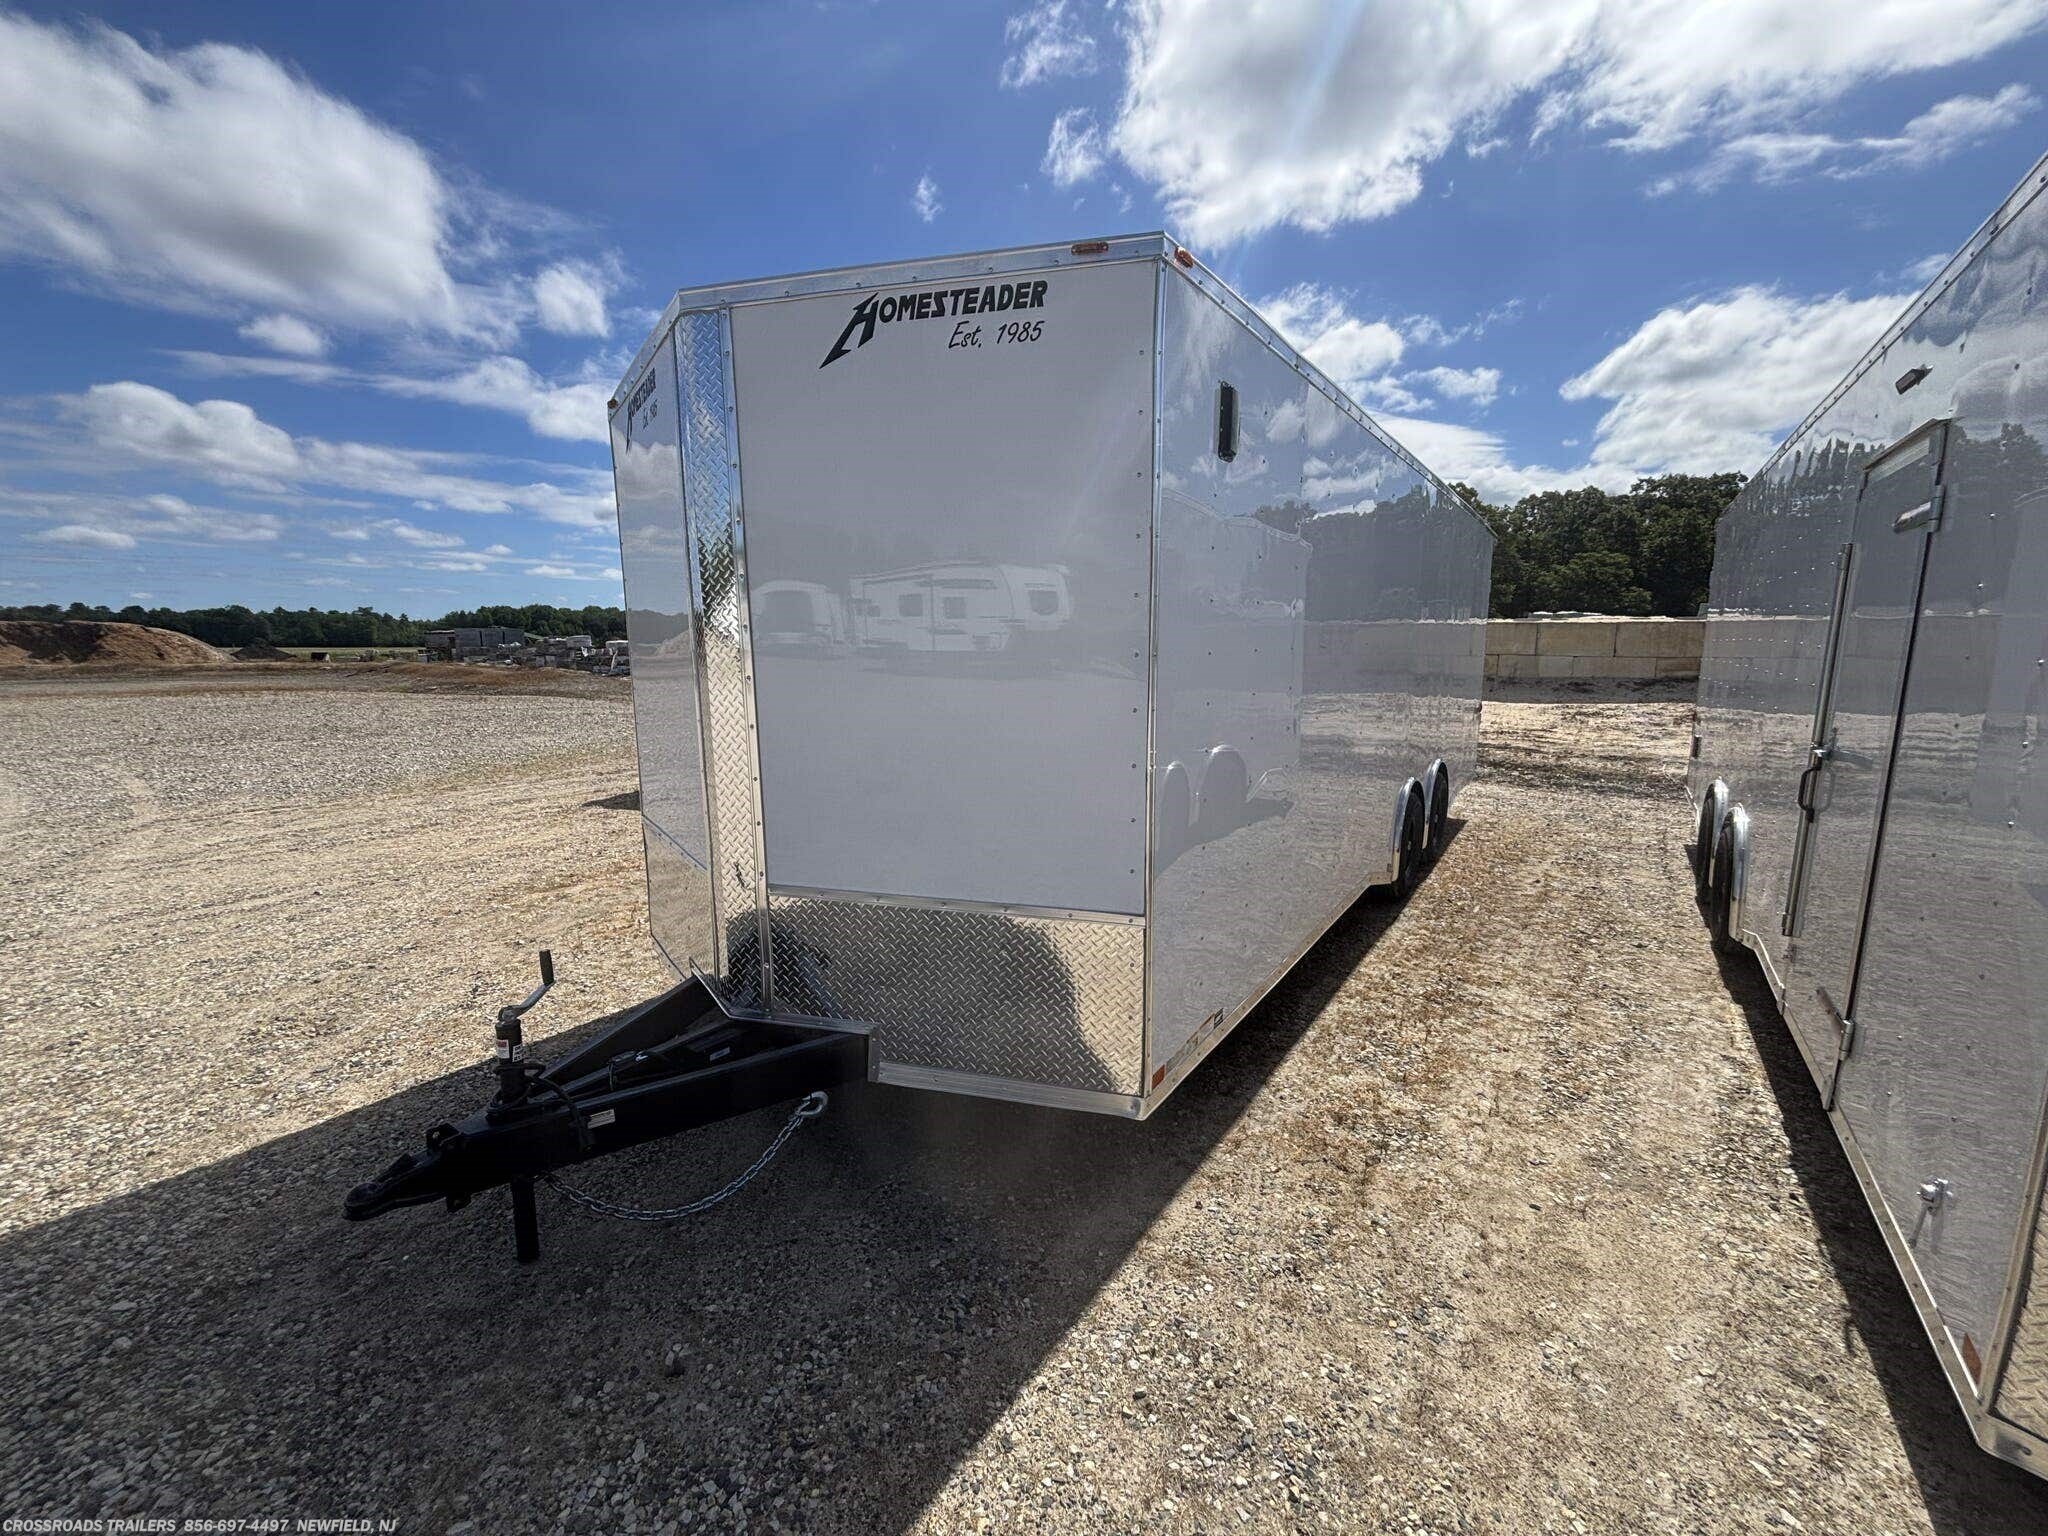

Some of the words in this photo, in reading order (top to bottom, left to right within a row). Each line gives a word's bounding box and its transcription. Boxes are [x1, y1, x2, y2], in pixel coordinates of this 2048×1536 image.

[819, 279, 1048, 369] HOMESTEADER
[948, 320, 982, 349] Est.
[996, 320, 1045, 345] 1985
